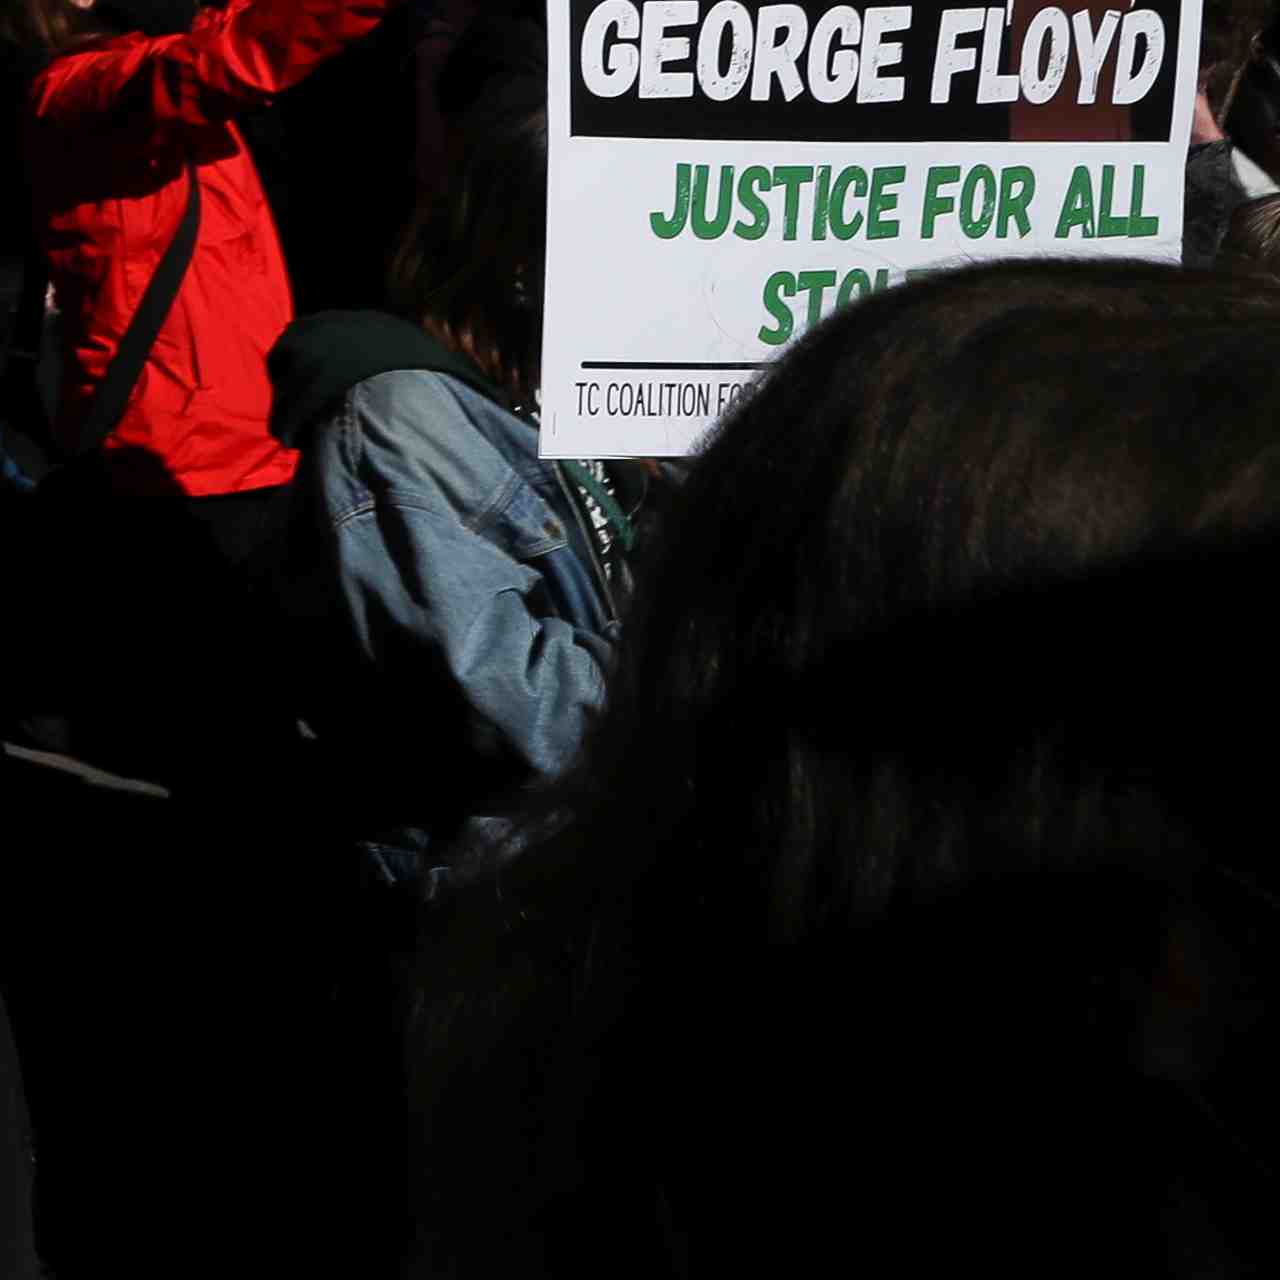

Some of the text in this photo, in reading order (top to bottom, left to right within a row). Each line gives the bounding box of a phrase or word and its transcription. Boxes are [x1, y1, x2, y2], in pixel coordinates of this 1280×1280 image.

[930, 5, 1166, 105] FLOYD
[649, 163, 1160, 241] JUSTICE FOR ALL
[575, 382, 600, 416] TC
[607, 382, 711, 417] COALITION
